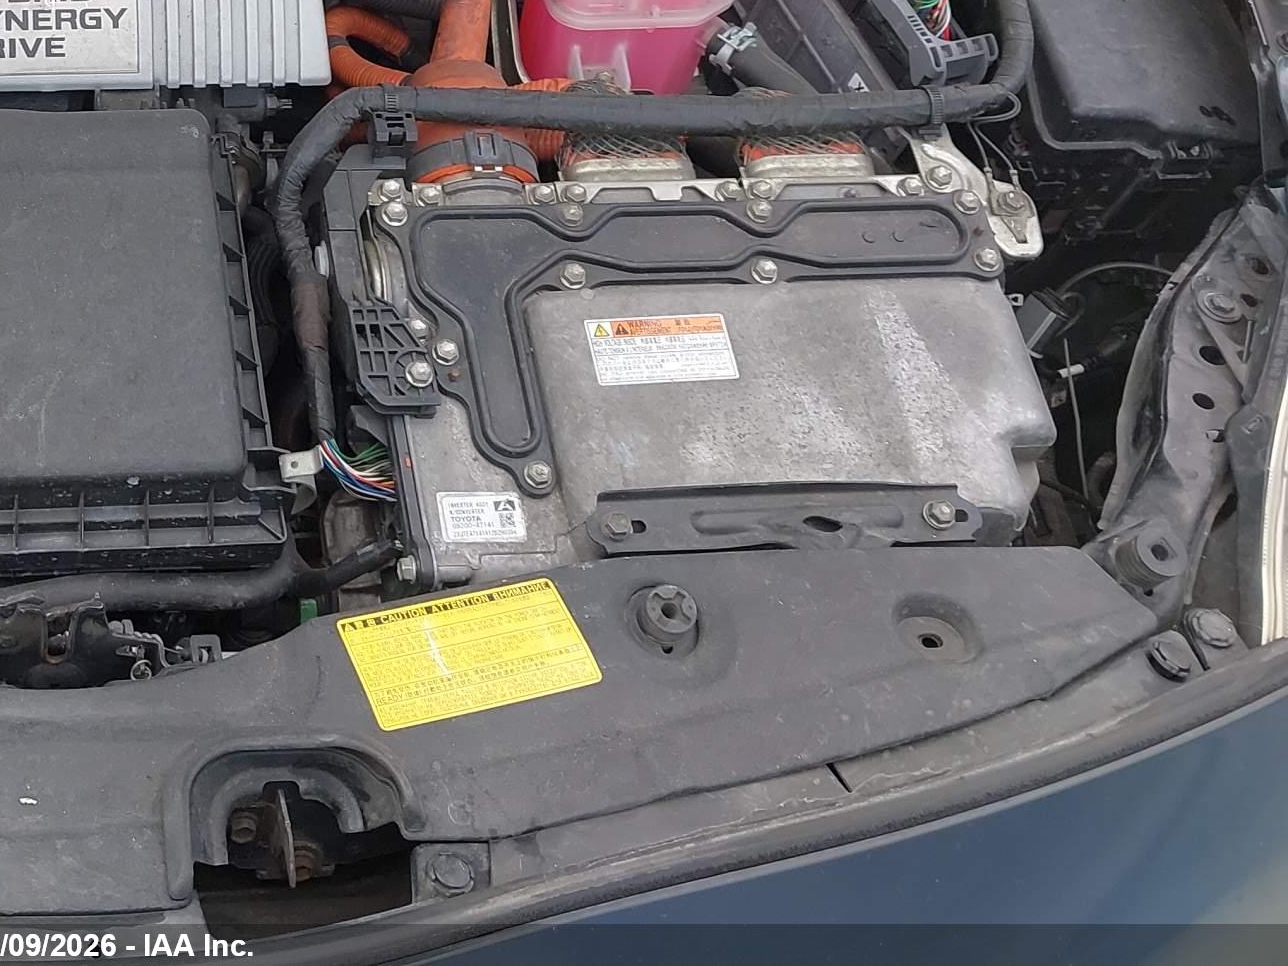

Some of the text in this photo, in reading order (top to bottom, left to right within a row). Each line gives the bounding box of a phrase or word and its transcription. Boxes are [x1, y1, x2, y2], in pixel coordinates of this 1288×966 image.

[628, 320, 662, 328] WARNING
[380, 607, 427, 625] CAUTION
[431, 594, 490, 613] ATTENTION
